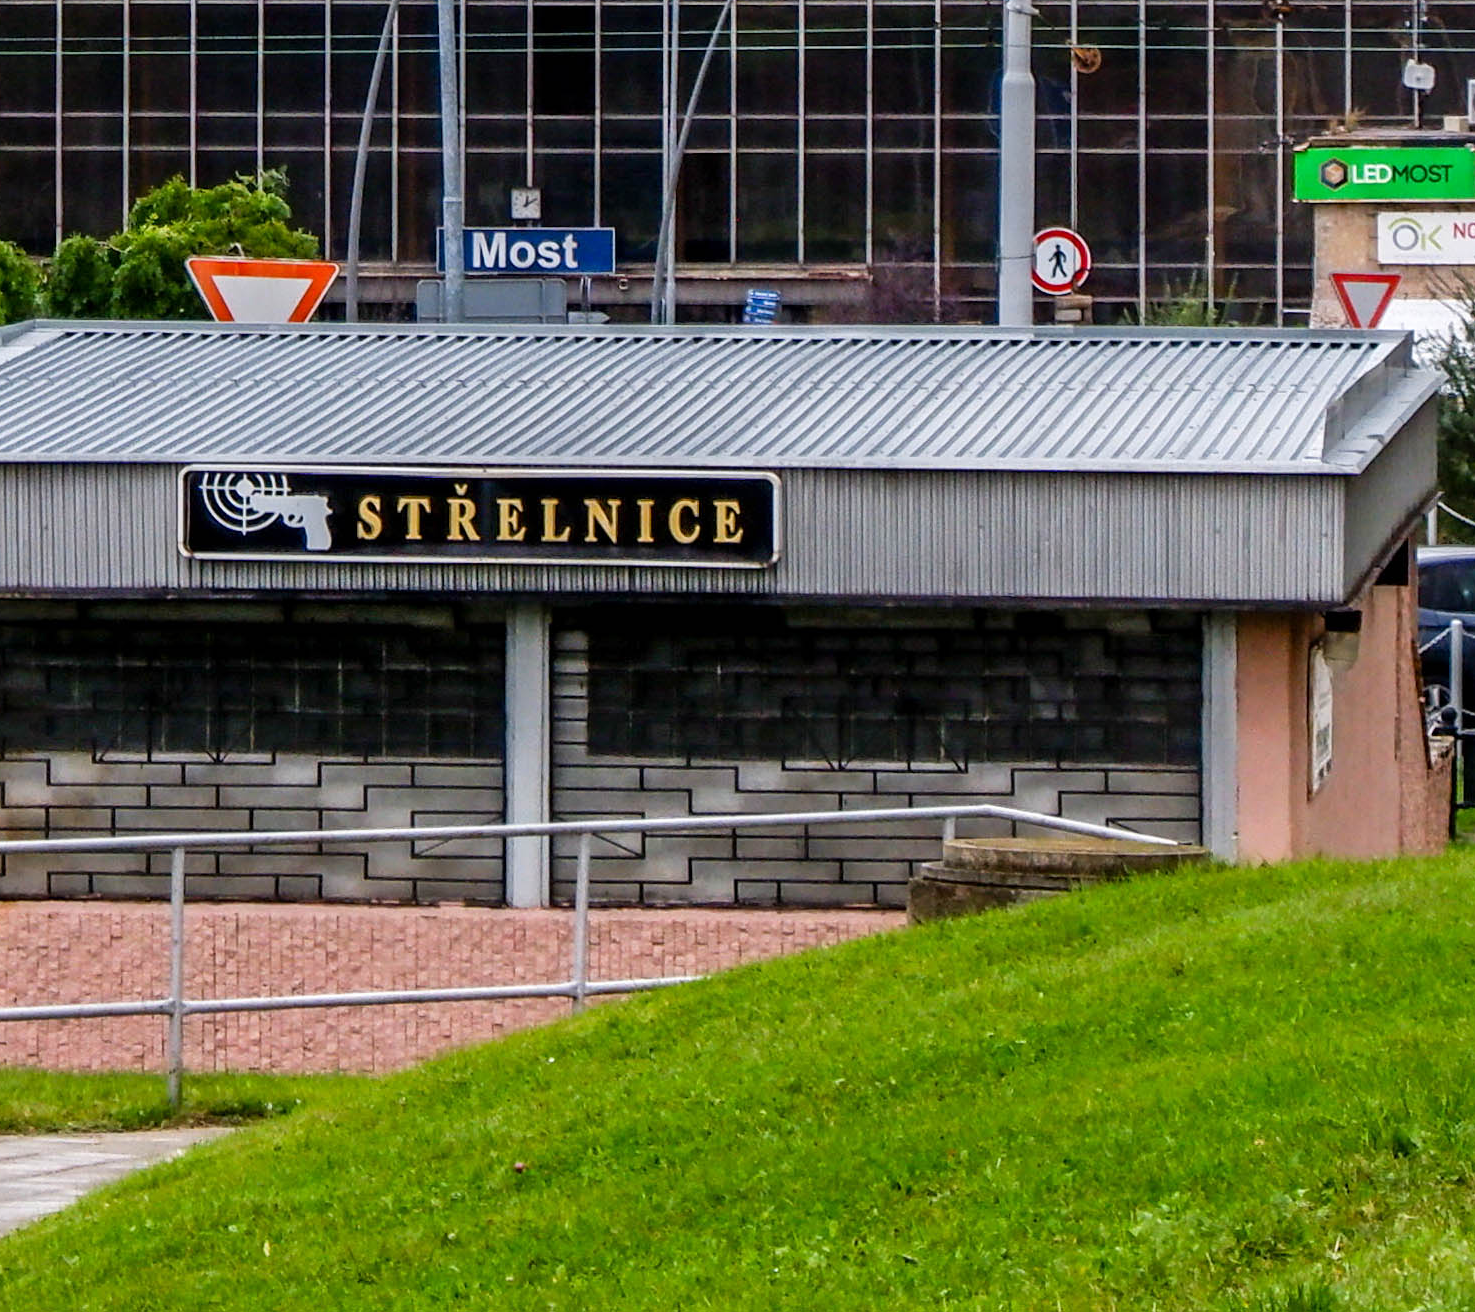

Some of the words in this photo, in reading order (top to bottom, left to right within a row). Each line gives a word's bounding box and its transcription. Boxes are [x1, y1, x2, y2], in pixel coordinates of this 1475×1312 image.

[1352, 164, 1453, 184] LEDMOST
[472, 232, 579, 269] Most
[357, 483, 743, 544] STŘELNICE
